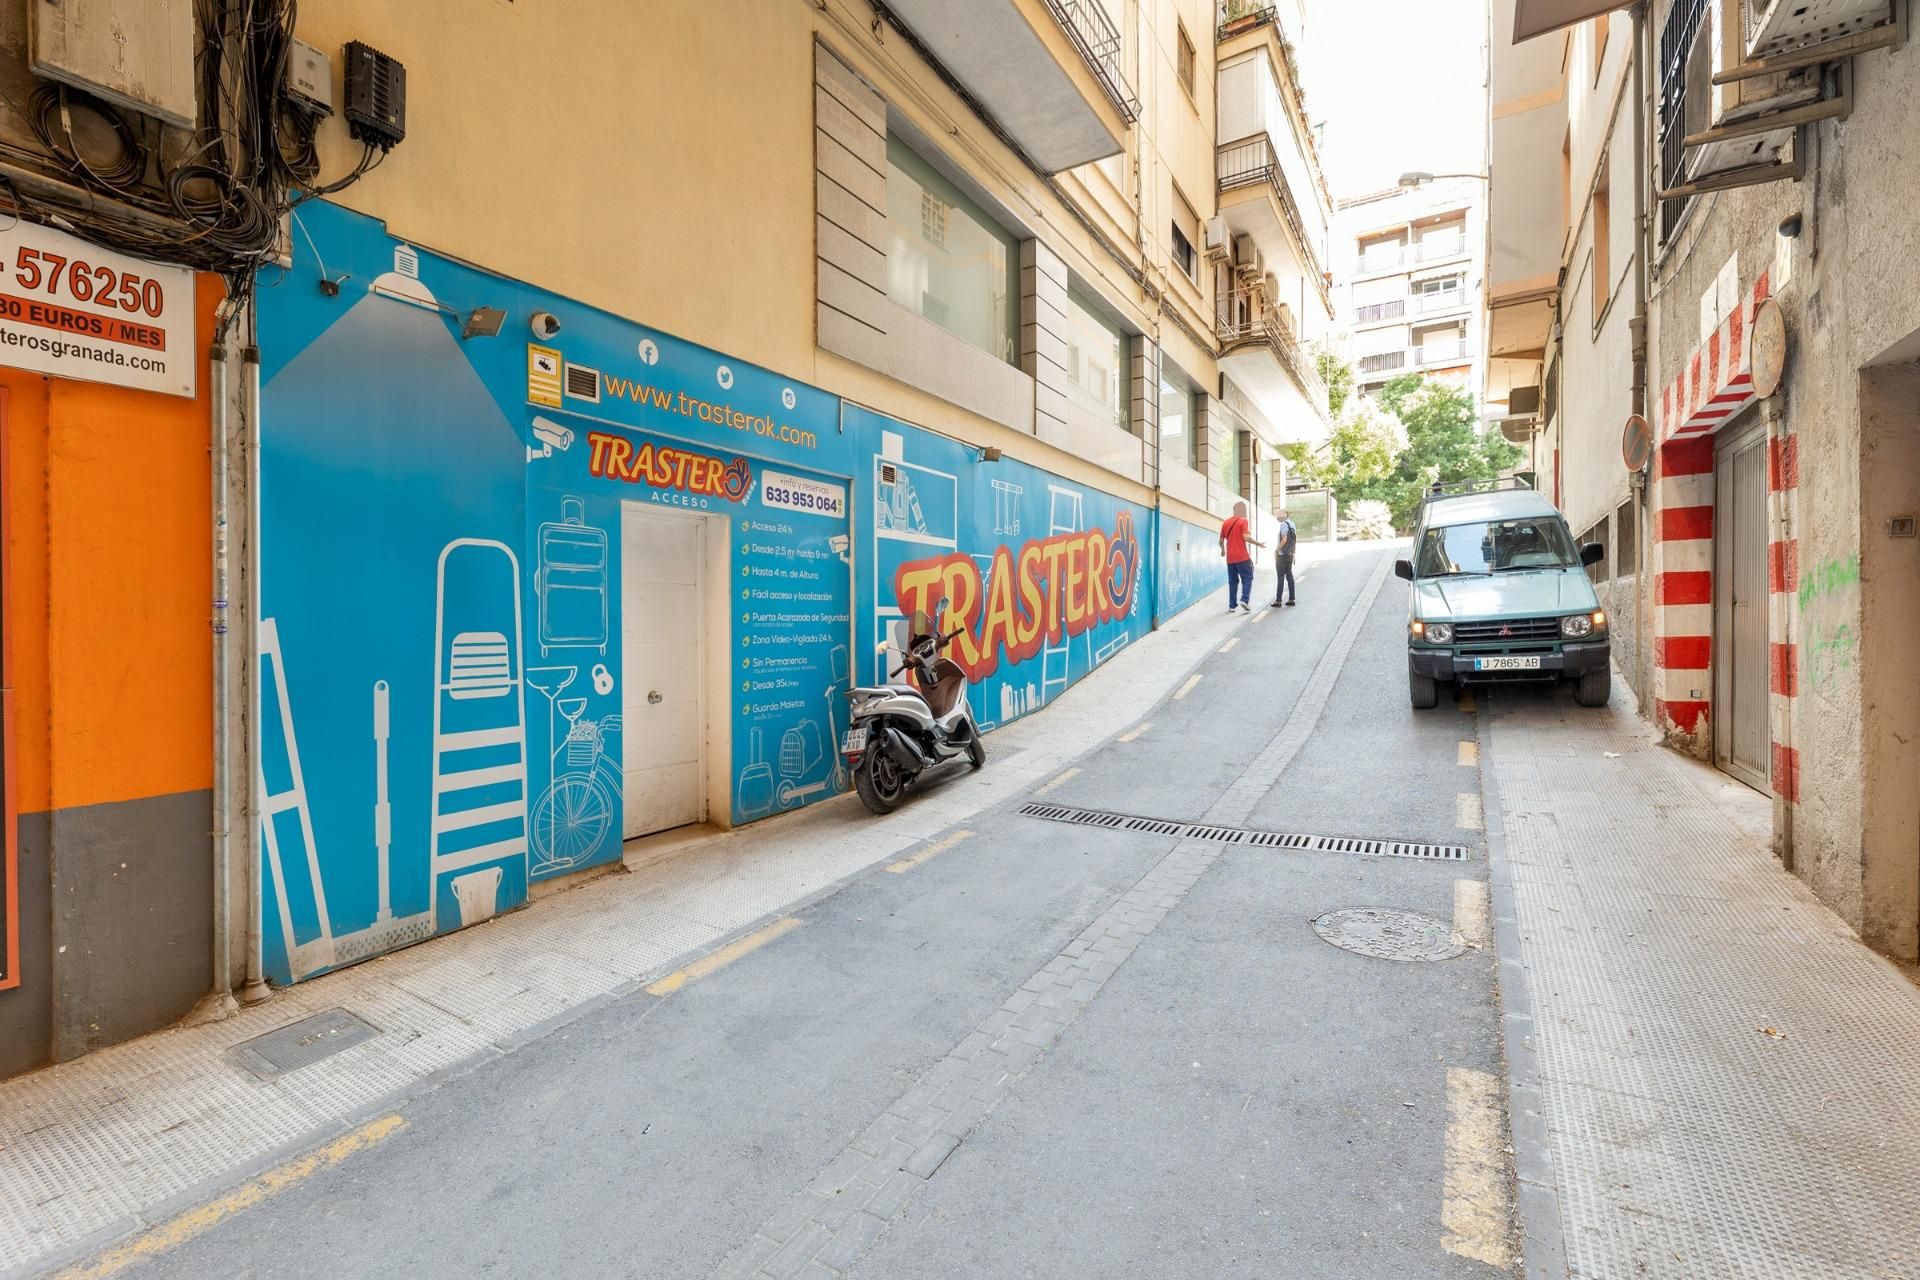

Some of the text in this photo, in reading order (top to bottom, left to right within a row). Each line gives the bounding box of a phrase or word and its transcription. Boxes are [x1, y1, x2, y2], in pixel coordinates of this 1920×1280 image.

[16, 246, 164, 318] 576250
[29, 305, 103, 335] EUROS
[120, 325, 161, 346] MES
[604, 374, 817, 449] www.trasterok.com
[651, 491, 709, 509] ACCESO
[766, 486, 837, 513] 633 953 064
[751, 521, 777, 532] Acceso
[777, 524, 787, 534] 24
[751, 544, 774, 554] Desde
[796, 549, 815, 559] hasta
[751, 566, 773, 577] Hasta
[773, 568, 779, 577] 4
[789, 569, 798, 578] de
[798, 569, 819, 580] Altura
[752, 589, 832, 603] Fácil acceso y localización
[752, 612, 776, 622] Puerta
[811, 614, 820, 622] de
[820, 614, 849, 624] Seguridad
[752, 634, 771, 645] Zona
[818, 633, 828, 643] 24
[752, 656, 808, 668] Sin Permanencia
[1493, 658, 1520, 668] 7865
[1525, 658, 1538, 667] AB
[752, 680, 774, 690] Desde
[752, 699, 806, 713] Guarda Maletas
